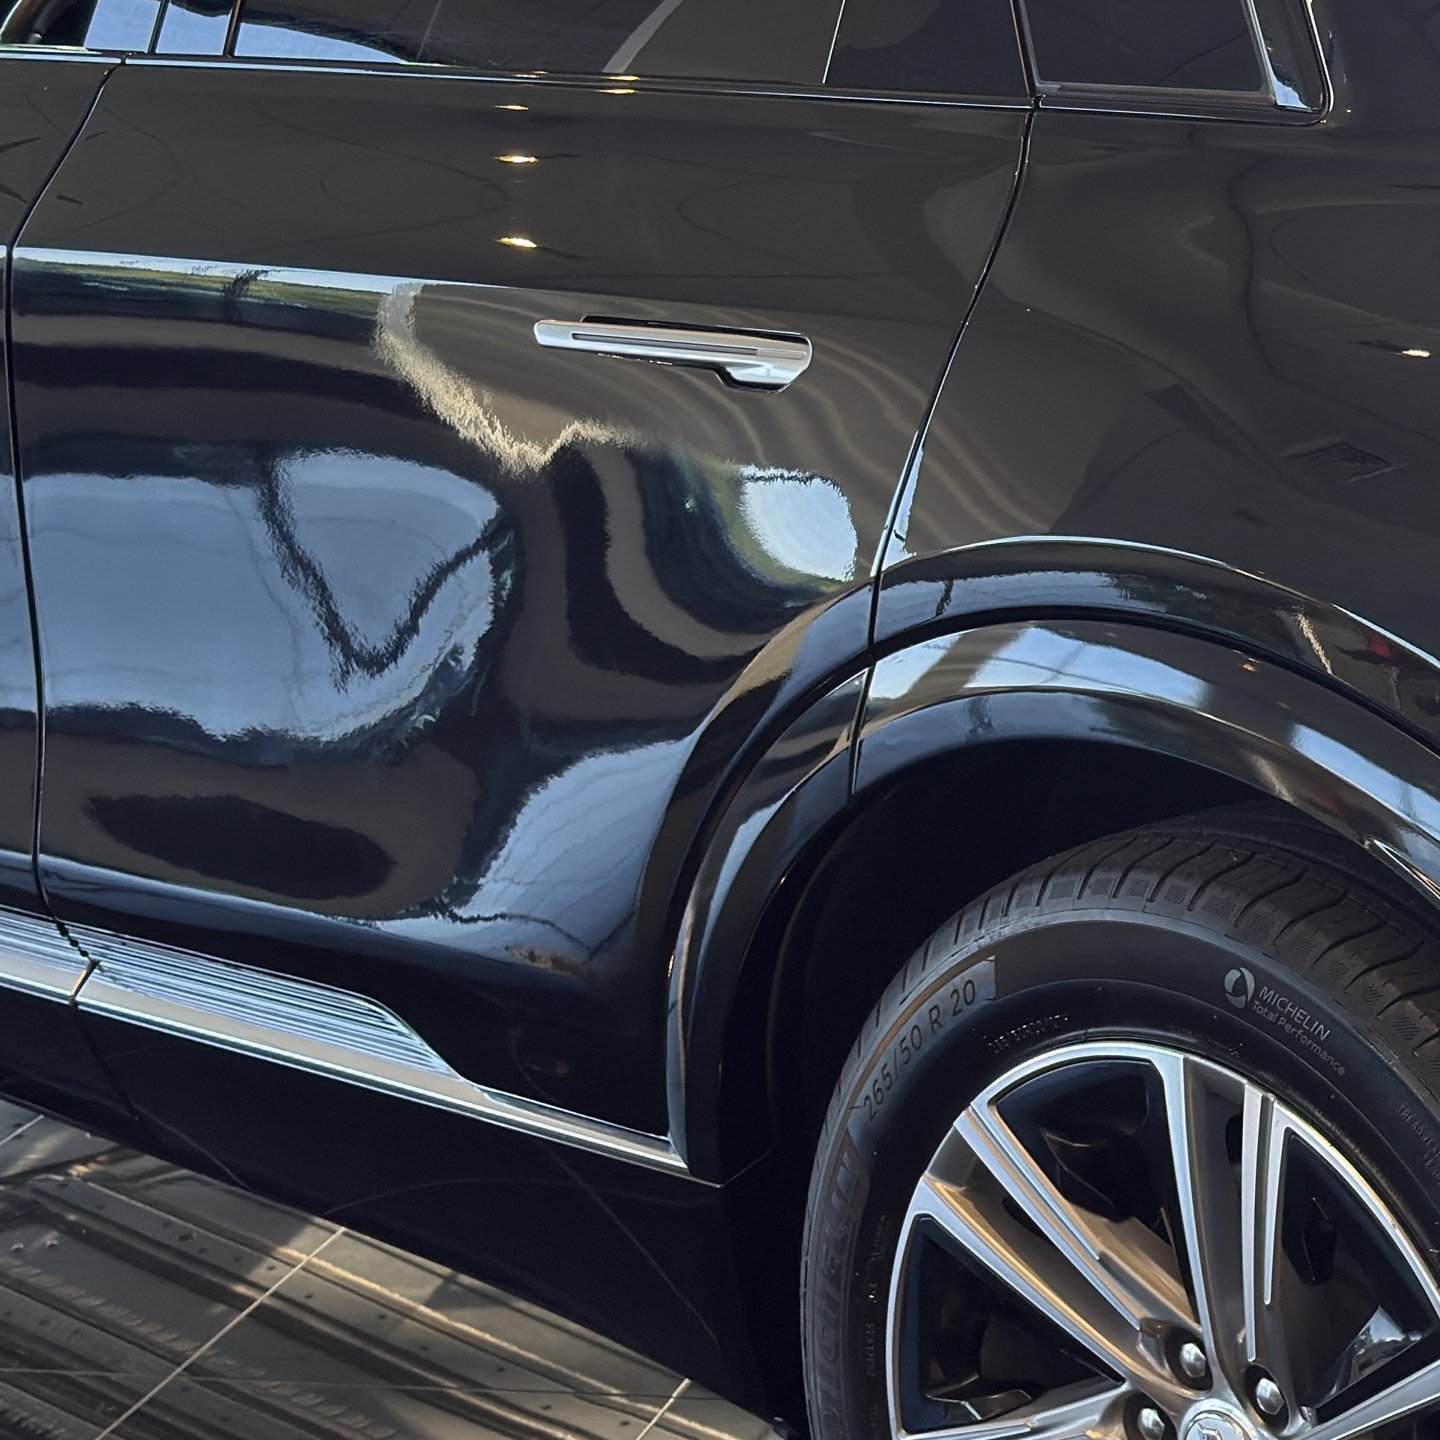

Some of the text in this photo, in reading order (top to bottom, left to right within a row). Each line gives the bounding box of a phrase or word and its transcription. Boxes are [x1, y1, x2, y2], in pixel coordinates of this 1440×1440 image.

[864, 979, 976, 1122] 265/50 R 20
[1251, 1000, 1346, 1075] Total Performance
[1259, 986, 1331, 1040] MICHELIN
